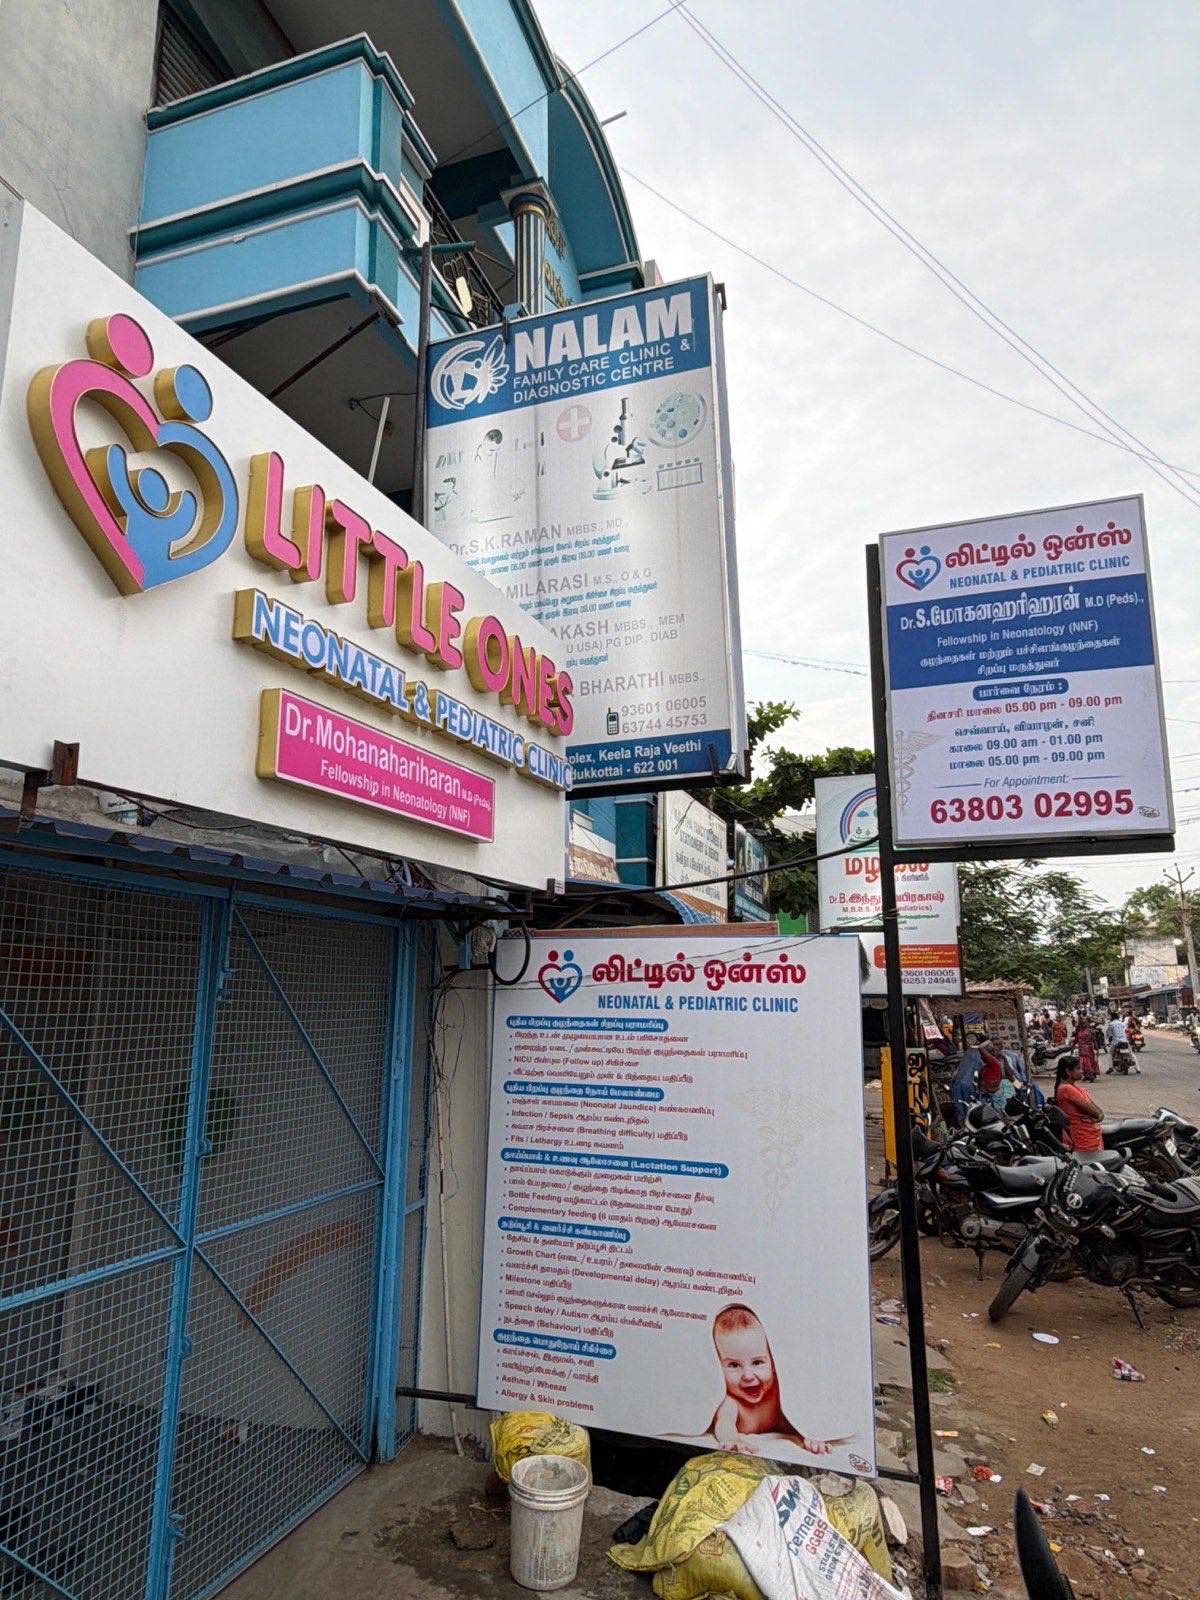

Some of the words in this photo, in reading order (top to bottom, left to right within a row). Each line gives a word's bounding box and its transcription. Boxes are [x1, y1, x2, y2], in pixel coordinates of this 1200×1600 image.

[515, 291, 693, 374] NALAM
[513, 367, 566, 389] FAMILY
[568, 357, 610, 376] CARE
[619, 343, 671, 364] CLINIC
[680, 338, 691, 351] &
[513, 373, 606, 404] DIAGNOSTIC
[610, 357, 675, 382] CENTRE
[252, 451, 465, 670] LITTLE
[945, 533, 1036, 568] லிட்டில்
[1043, 521, 1132, 560] ஒன்ஸ்
[949, 571, 1007, 589] NEONATAL
[1010, 570, 1019, 581] &
[1022, 561, 1086, 579] PEDIATRIC
[1089, 555, 1131, 572] CLINIC
[605, 637, 621, 648] PG
[937, 631, 988, 648] Fellowship
[1002, 625, 1065, 644] Neonatology
[1068, 620, 1099, 637] (NNF)
[251, 590, 410, 713] NEONATAL
[412, 680, 432, 720] &
[435, 689, 526, 768] PEDIATRIC
[527, 742, 573, 792] CLINIC
[470, 614, 575, 737] ONES
[580, 671, 664, 696] BHARATHI
[621, 701, 660, 717] 93601
[665, 695, 707, 712] 06005
[1005, 700, 1037, 713] 05.00
[1039, 700, 1057, 714] pm
[1068, 695, 1102, 709] 09.00
[1104, 695, 1122, 708] pm
[622, 718, 662, 734] 63744
[666, 713, 707, 729] 45753
[285, 702, 461, 799] Dr.Mohanahariharan
[599, 748, 632, 761] Keela
[634, 745, 661, 759] Raja
[663, 738, 701, 754] Veethi
[986, 737, 1018, 751] 09.00
[1020, 738, 1038, 748] am
[1049, 733, 1083, 747] 01.00
[1085, 733, 1104, 746] pm
[988, 754, 1020, 768] 05.00
[1022, 755, 1040, 768] pm
[1051, 750, 1085, 764] 09.00
[1087, 750, 1105, 763] pm
[633, 761, 657, 774] 622
[657, 758, 678, 772] 001
[984, 776, 1001, 788] For
[1002, 773, 1070, 789] Appointment:
[320, 759, 380, 796] Fellowship
[381, 781, 391, 796] in
[393, 786, 448, 819] Neonatology
[449, 803, 471, 827] (NNF)
[930, 794, 1024, 824] 63803
[1033, 788, 1134, 818] 02995
[592, 952, 696, 989] லிட்டில்
[703, 951, 807, 991] ஒன்ஸ்
[598, 994, 660, 1010] NEONATAL
[664, 995, 674, 1010] &
[678, 995, 748, 1012] PEDIATRIC
[752, 996, 799, 1013] CLINIC
[805, 1518, 829, 1556] GGBS
